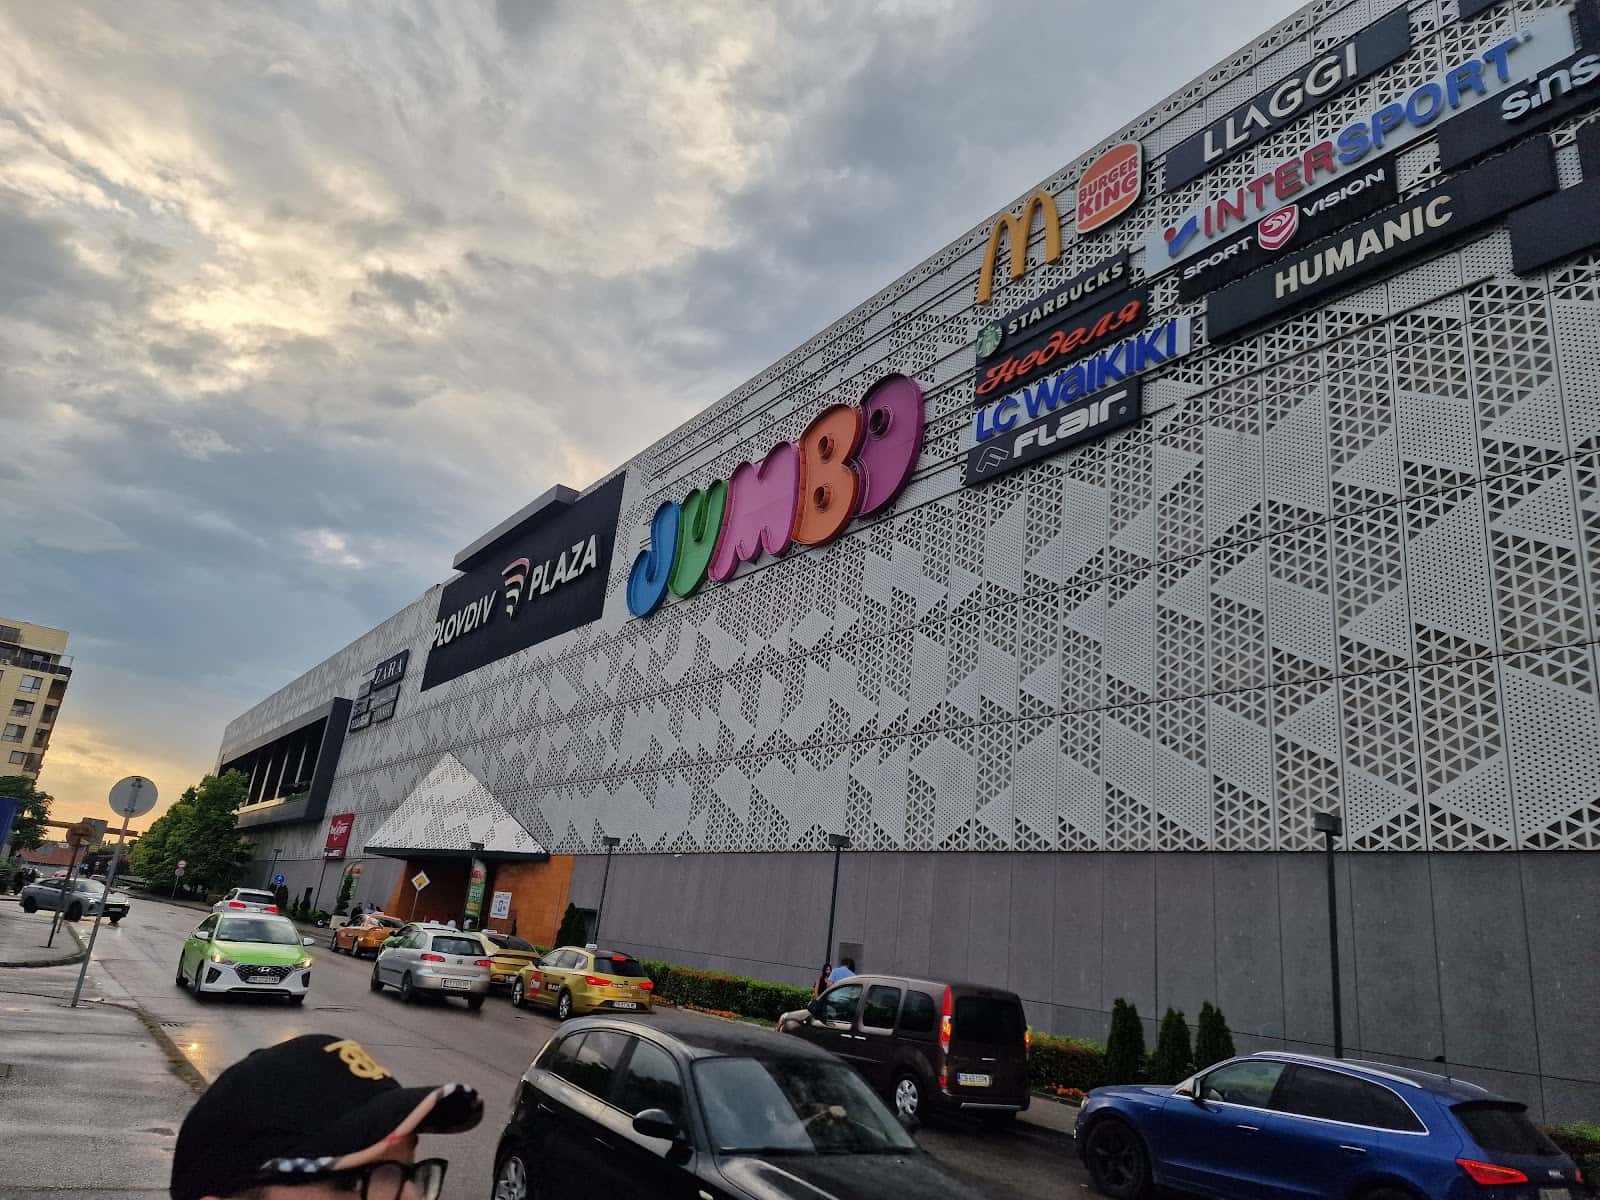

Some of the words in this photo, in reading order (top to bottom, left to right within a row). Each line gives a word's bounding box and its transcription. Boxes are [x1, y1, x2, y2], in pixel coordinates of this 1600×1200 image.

[1079, 155, 1138, 204] BURGER
[1204, 36, 1518, 238] INTERSPORT
[1078, 171, 1137, 223] KING
[1184, 236, 1253, 280] SPORT
[1303, 168, 1385, 217] VISION
[1275, 195, 1452, 299] HUMANIC
[1008, 261, 1125, 335] STARBUCKS
[976, 396, 1020, 442] LC
[626, 373, 924, 618] JUMBO
[432, 590, 497, 647] PLOVDIV
[528, 534, 598, 600] PLAZA
[374, 658, 403, 685] ZARA
